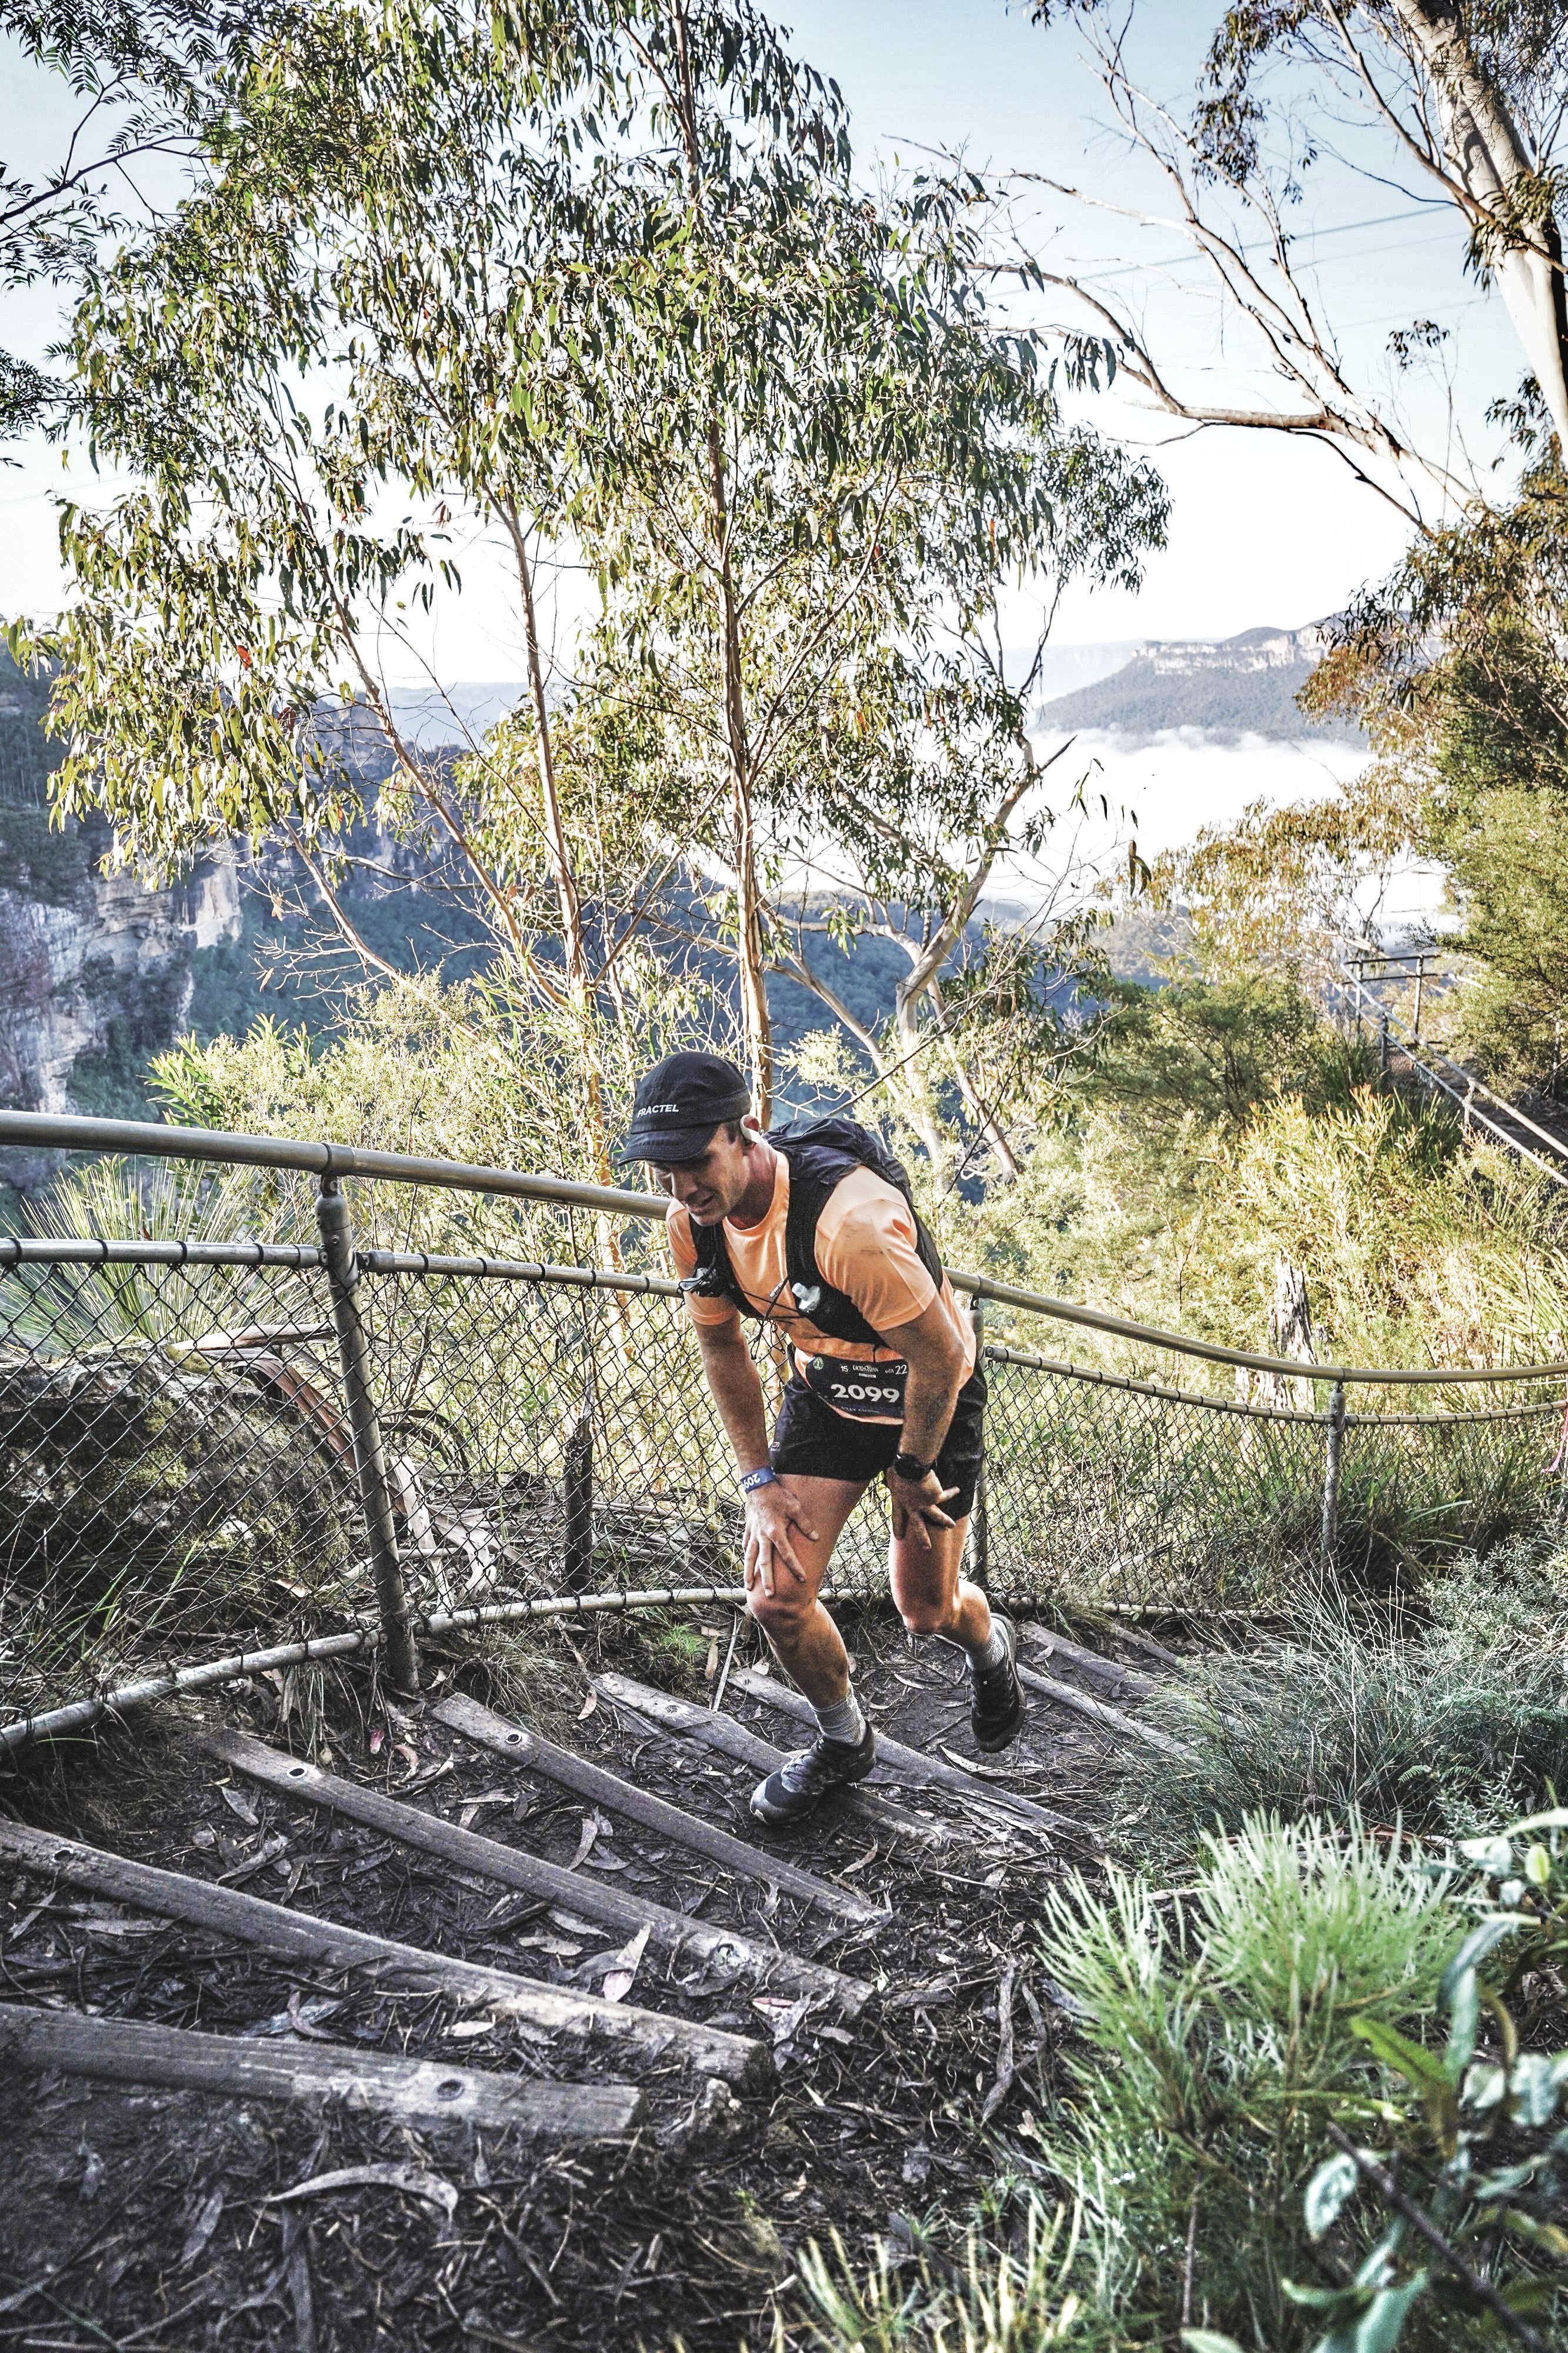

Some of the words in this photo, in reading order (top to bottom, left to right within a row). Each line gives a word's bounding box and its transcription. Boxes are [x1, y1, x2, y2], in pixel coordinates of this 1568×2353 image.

[637, 1104, 679, 1118] FRACTEL
[895, 1364, 908, 1375] 22
[830, 1384, 900, 1403] 2099
